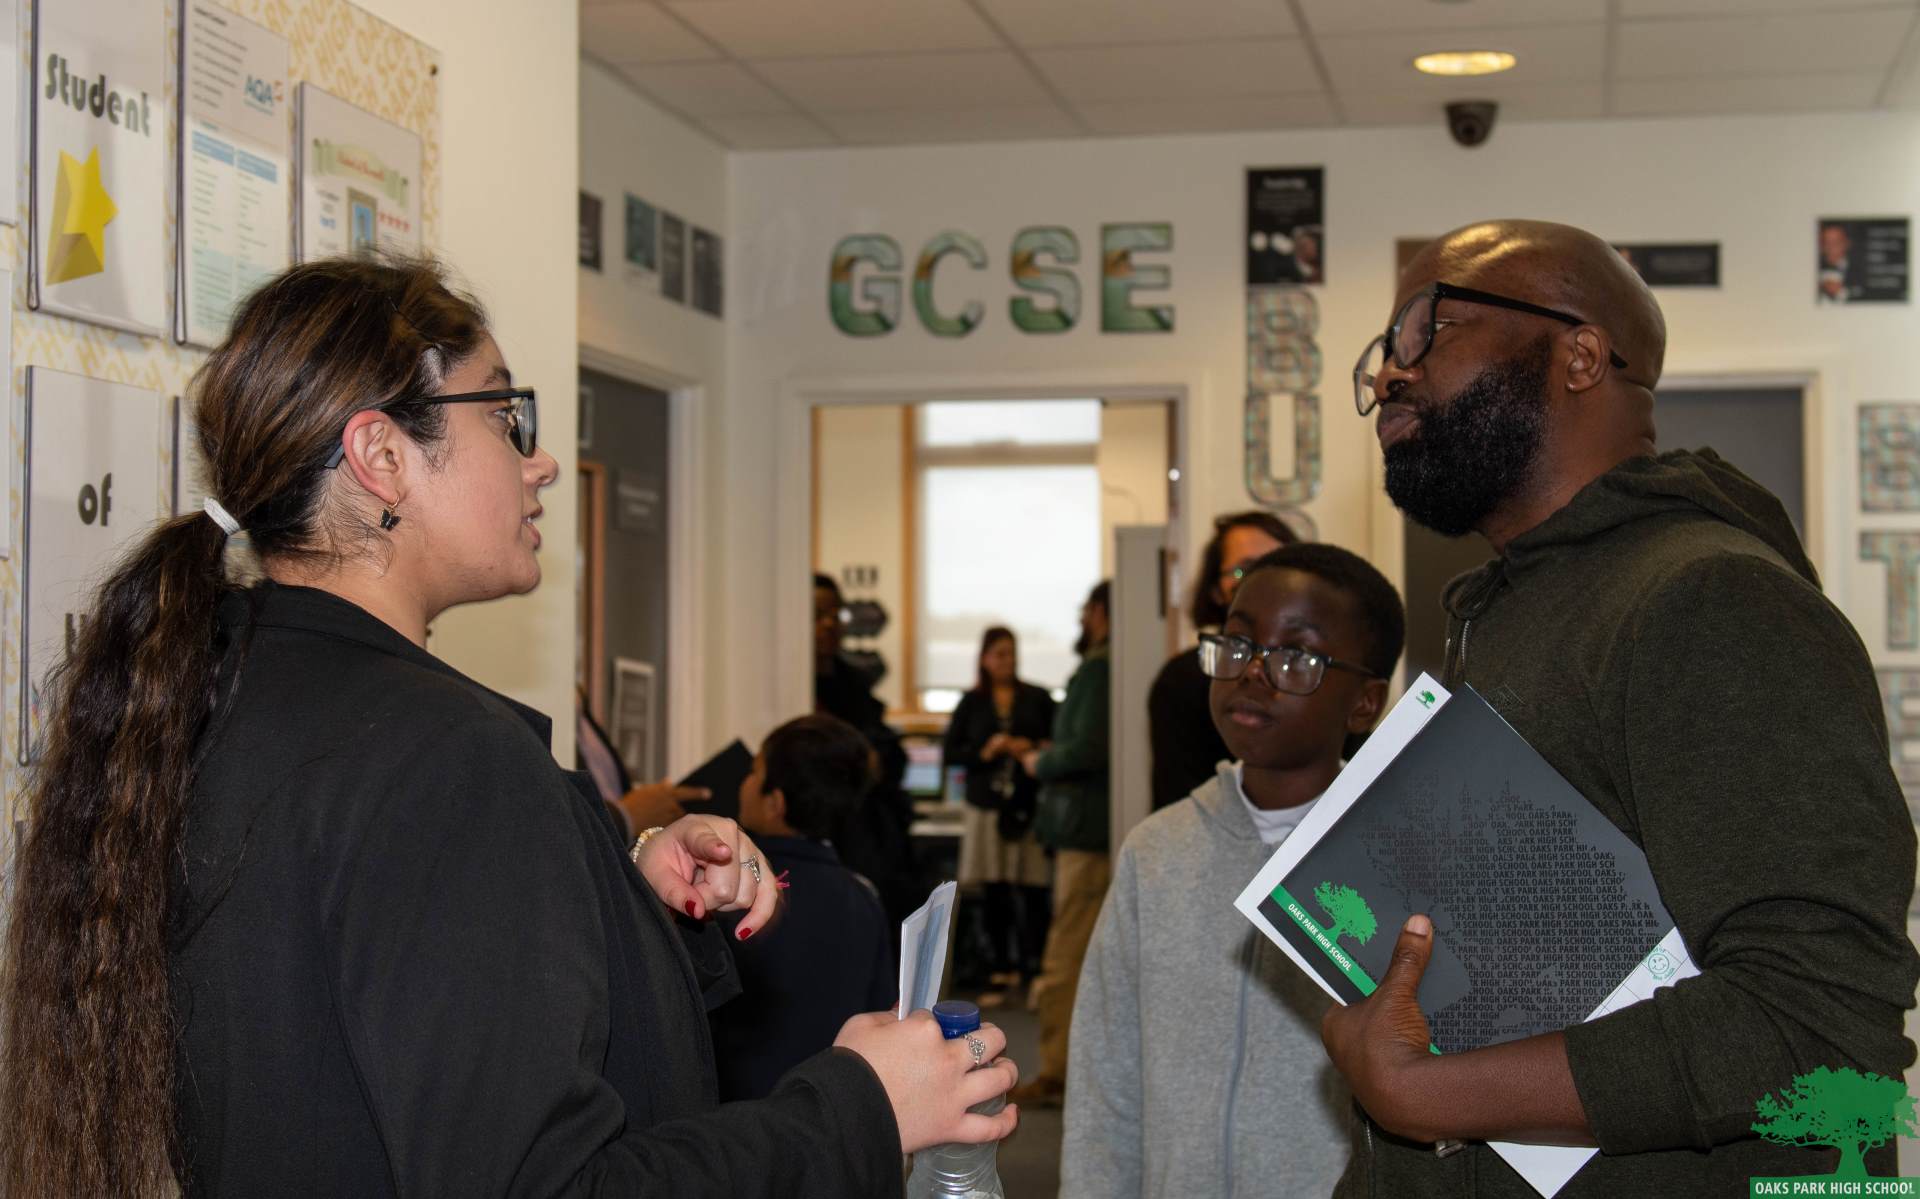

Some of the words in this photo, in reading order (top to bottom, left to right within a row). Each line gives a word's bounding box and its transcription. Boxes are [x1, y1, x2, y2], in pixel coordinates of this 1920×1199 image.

[45, 53, 150, 138] Student
[827, 222, 1176, 338] GCSE
[78, 473, 112, 527] of
[1528, 811, 1550, 819] OAKS
[1552, 810, 1572, 818] PARK
[1537, 819, 1556, 827] HIGH
[1558, 818, 1577, 827] SCH
[1529, 828, 1550, 836] OAKS
[1553, 827, 1573, 835] PARK
[1497, 837, 1513, 845] AKS
[1537, 836, 1556, 844] HIGH
[1559, 835, 1577, 843] SCH
[1530, 844, 1551, 852] OAKS
[1554, 844, 1574, 852] PARK
[1538, 852, 1558, 861] HIGH
[1560, 852, 1591, 860] SCHOOL
[1497, 861, 1529, 870] SCHOOL
[1531, 861, 1553, 869] OAKS
[1555, 861, 1575, 869] PARK
[1577, 860, 1597, 868] HIGH
[1493, 870, 1514, 878] OAKS
[1516, 870, 1537, 878] PARK
[1539, 869, 1559, 877] HIGH
[1561, 869, 1592, 877] SCHOOL
[1594, 868, 1616, 876] OAKS
[1499, 878, 1529, 886] SCHOOL
[1531, 878, 1553, 886] OAKS
[1555, 877, 1576, 885] PARK
[1578, 877, 1598, 885] HIGH
[1517, 886, 1538, 894] PARK
[1540, 886, 1560, 894] HIGH
[1562, 886, 1593, 894] SCHOOL
[1596, 885, 1618, 893] OAKS
[1532, 894, 1554, 902] OAKS
[1556, 894, 1577, 902] PARK
[1579, 894, 1599, 902] HIGH
[1495, 903, 1517, 911] OAKS
[1519, 903, 1539, 911] PARK
[1541, 903, 1561, 911] HIGH
[1563, 902, 1594, 911] SCHOOL
[1597, 902, 1618, 910] OAKS
[1479, 912, 1499, 920] HIGH
[1501, 911, 1531, 919] SCHOOL
[1534, 911, 1555, 919] OAKS
[1557, 911, 1578, 919] PARK
[1580, 911, 1600, 919] HIGH
[1603, 911, 1634, 919] SCHOOL
[1463, 920, 1493, 928] SCHOOL
[1496, 920, 1517, 928] OAKS
[1519, 920, 1540, 928] PARK
[1542, 920, 1562, 928] HIGH
[1564, 919, 1595, 927] SCHOOL
[1598, 919, 1619, 927] OAKS
[1501, 928, 1532, 936] SCHOOL
[1534, 928, 1556, 936] OAKS
[1558, 928, 1579, 936] PARK
[1582, 928, 1601, 936] HIGH
[1604, 928, 1635, 936] SCHOOL
[1288, 903, 1304, 921] OAKS
[1302, 918, 1319, 935] PARK
[1316, 932, 1331, 949] HIGH
[1329, 946, 1352, 971] SCHOOL
[1520, 936, 1541, 944] PARK
[1543, 936, 1562, 944] HIGH
[1565, 936, 1596, 944] SCHOOL
[1599, 936, 1620, 944] OAKS
[1623, 936, 1644, 944] PARK
[1458, 945, 1478, 953] PARK
[1535, 945, 1557, 953] OAKS
[1559, 945, 1580, 953] PARK
[1582, 945, 1602, 953] HIGH
[1605, 945, 1635, 953] SCHOOL
[1497, 953, 1518, 961] OAKS
[1520, 953, 1541, 961] PARK
[1544, 953, 1563, 961] HIGH
[1566, 953, 1597, 961] SCHOOL
[1600, 953, 1621, 961] OAKS
[1560, 962, 1580, 970] PARK
[1583, 962, 1603, 970] HIGH
[1497, 970, 1519, 978] OAKS
[1566, 970, 1597, 978] SCHOOL
[1480, 978, 1501, 986] HIGH
[1583, 979, 1603, 987] HIGH
[1521, 987, 1541, 995] PARK
[1566, 987, 1597, 995] SCHOOL
[1481, 995, 1501, 1003] HIGH
[1502, 995, 1533, 1003] SCHOOL
[1560, 995, 1580, 1003] PARK
[1463, 1003, 1494, 1011] SCHOOL
[1433, 1011, 1455, 1019] OAKS
[1457, 1011, 1478, 1019] PARK
[1480, 1011, 1500, 1019] HIGH
[1440, 1019, 1461, 1027] HIGH
[1463, 1020, 1494, 1028] SCHOOL
[1433, 1027, 1455, 1035] OAKS
[1457, 1028, 1478, 1036] PARK
[1480, 1028, 1500, 1036] HIGH
[1440, 1036, 1461, 1044] HIGH
